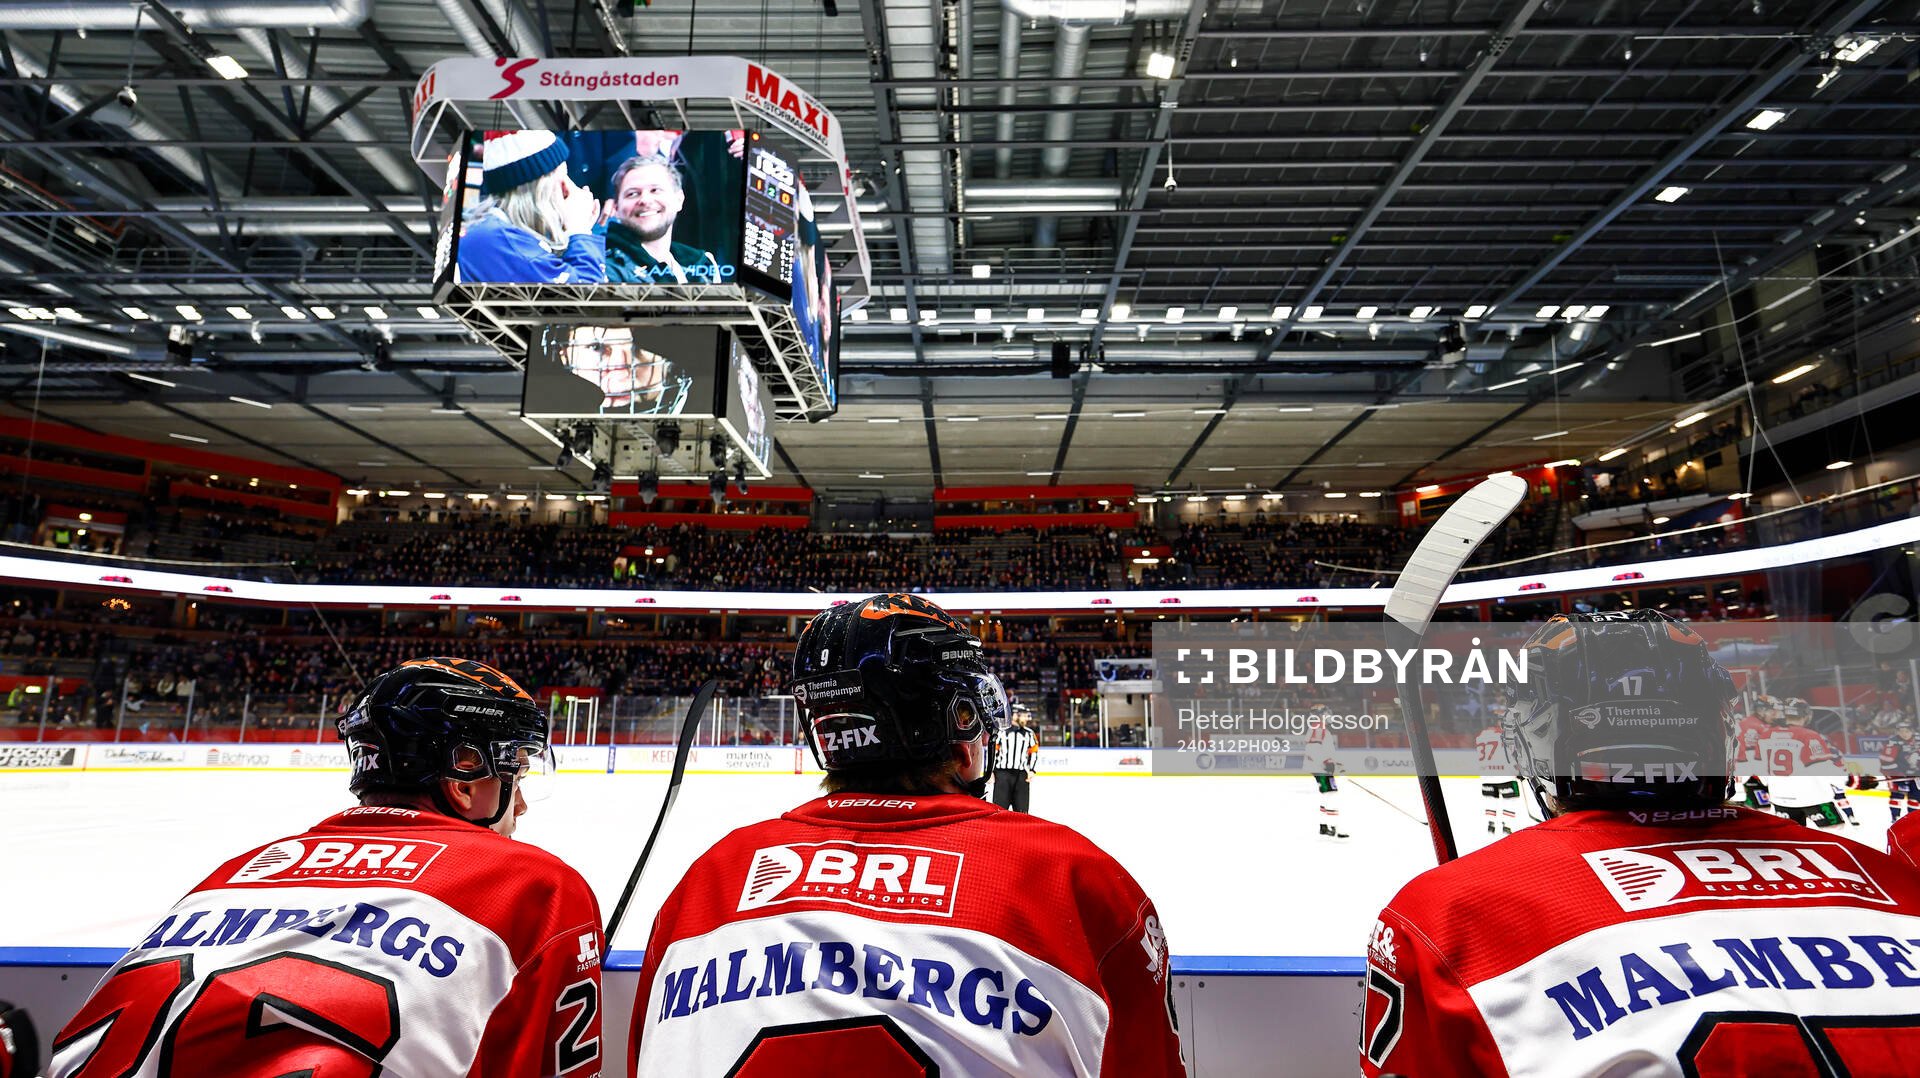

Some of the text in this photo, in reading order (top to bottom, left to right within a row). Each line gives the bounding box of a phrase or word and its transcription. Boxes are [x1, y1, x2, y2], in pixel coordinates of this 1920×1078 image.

[540, 70, 679, 91] Stångåstaden
[746, 64, 829, 138] MAXI
[820, 648, 829, 667] 9
[807, 679, 838, 691] Thermia
[808, 686, 862, 700] Värmepumpar
[1618, 675, 1643, 696] 17
[453, 704, 505, 717] BAUER
[1606, 705, 1661, 717] Thermia
[1607, 717, 1699, 728] Värmepumpar
[1478, 740, 1499, 762] 37
[351, 806, 421, 818] BAUER
[838, 799, 917, 810] BAUER
[1652, 808, 1738, 823] BAUER
[299, 842, 419, 870] BRL
[1673, 848, 1868, 884] BRL
[293, 868, 411, 877] ELECTRONICS
[804, 849, 946, 896] BRL
[801, 885, 943, 906] ELECTRONICS
[1704, 882, 1876, 895] ELECTRONICS
[127, 902, 464, 979] ALMBERGS
[657, 941, 1053, 1036] MALMBERGS
[555, 977, 600, 1077] 2
